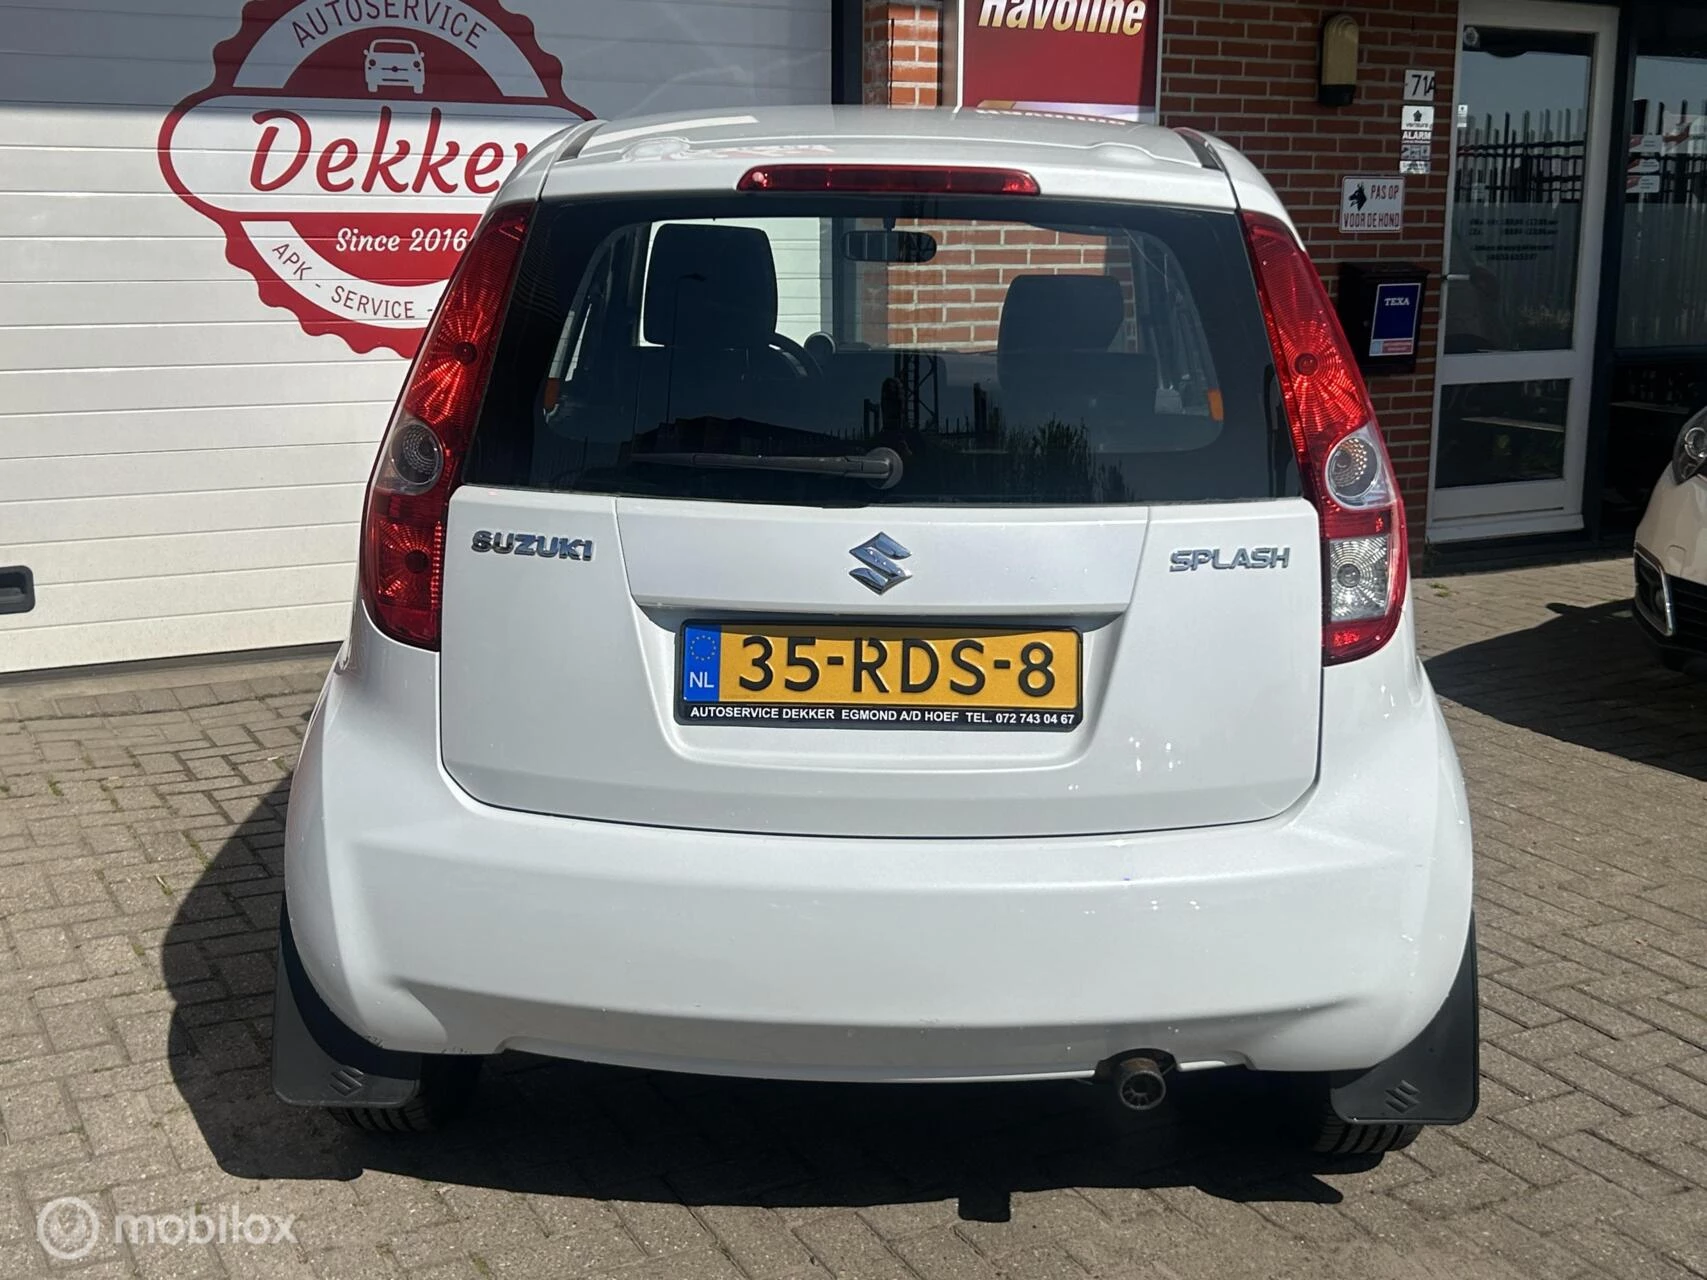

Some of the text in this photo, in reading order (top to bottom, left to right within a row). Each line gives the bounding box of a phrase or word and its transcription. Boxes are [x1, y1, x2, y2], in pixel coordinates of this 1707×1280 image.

[292, 0, 487, 49] AUTOSERVICE
[1402, 130, 1432, 141] ALARM
[1370, 184, 1399, 200] PAS OP
[1343, 212, 1400, 228] VOOR DE HOND
[335, 227, 468, 252] Since 2016
[272, 243, 313, 280] APK
[331, 285, 416, 319] SERVICE
[1383, 297, 1410, 307] TEXA
[471, 529, 593, 562] SUZUKI
[1169, 546, 1291, 573] SPLASH
[738, 634, 1056, 698] 35-RDS-8
[688, 670, 715, 689] NL
[690, 706, 1075, 725] AUTOSERVICE DEKKER EGMOND A/D HOEF TEL. 072 743 04 67
